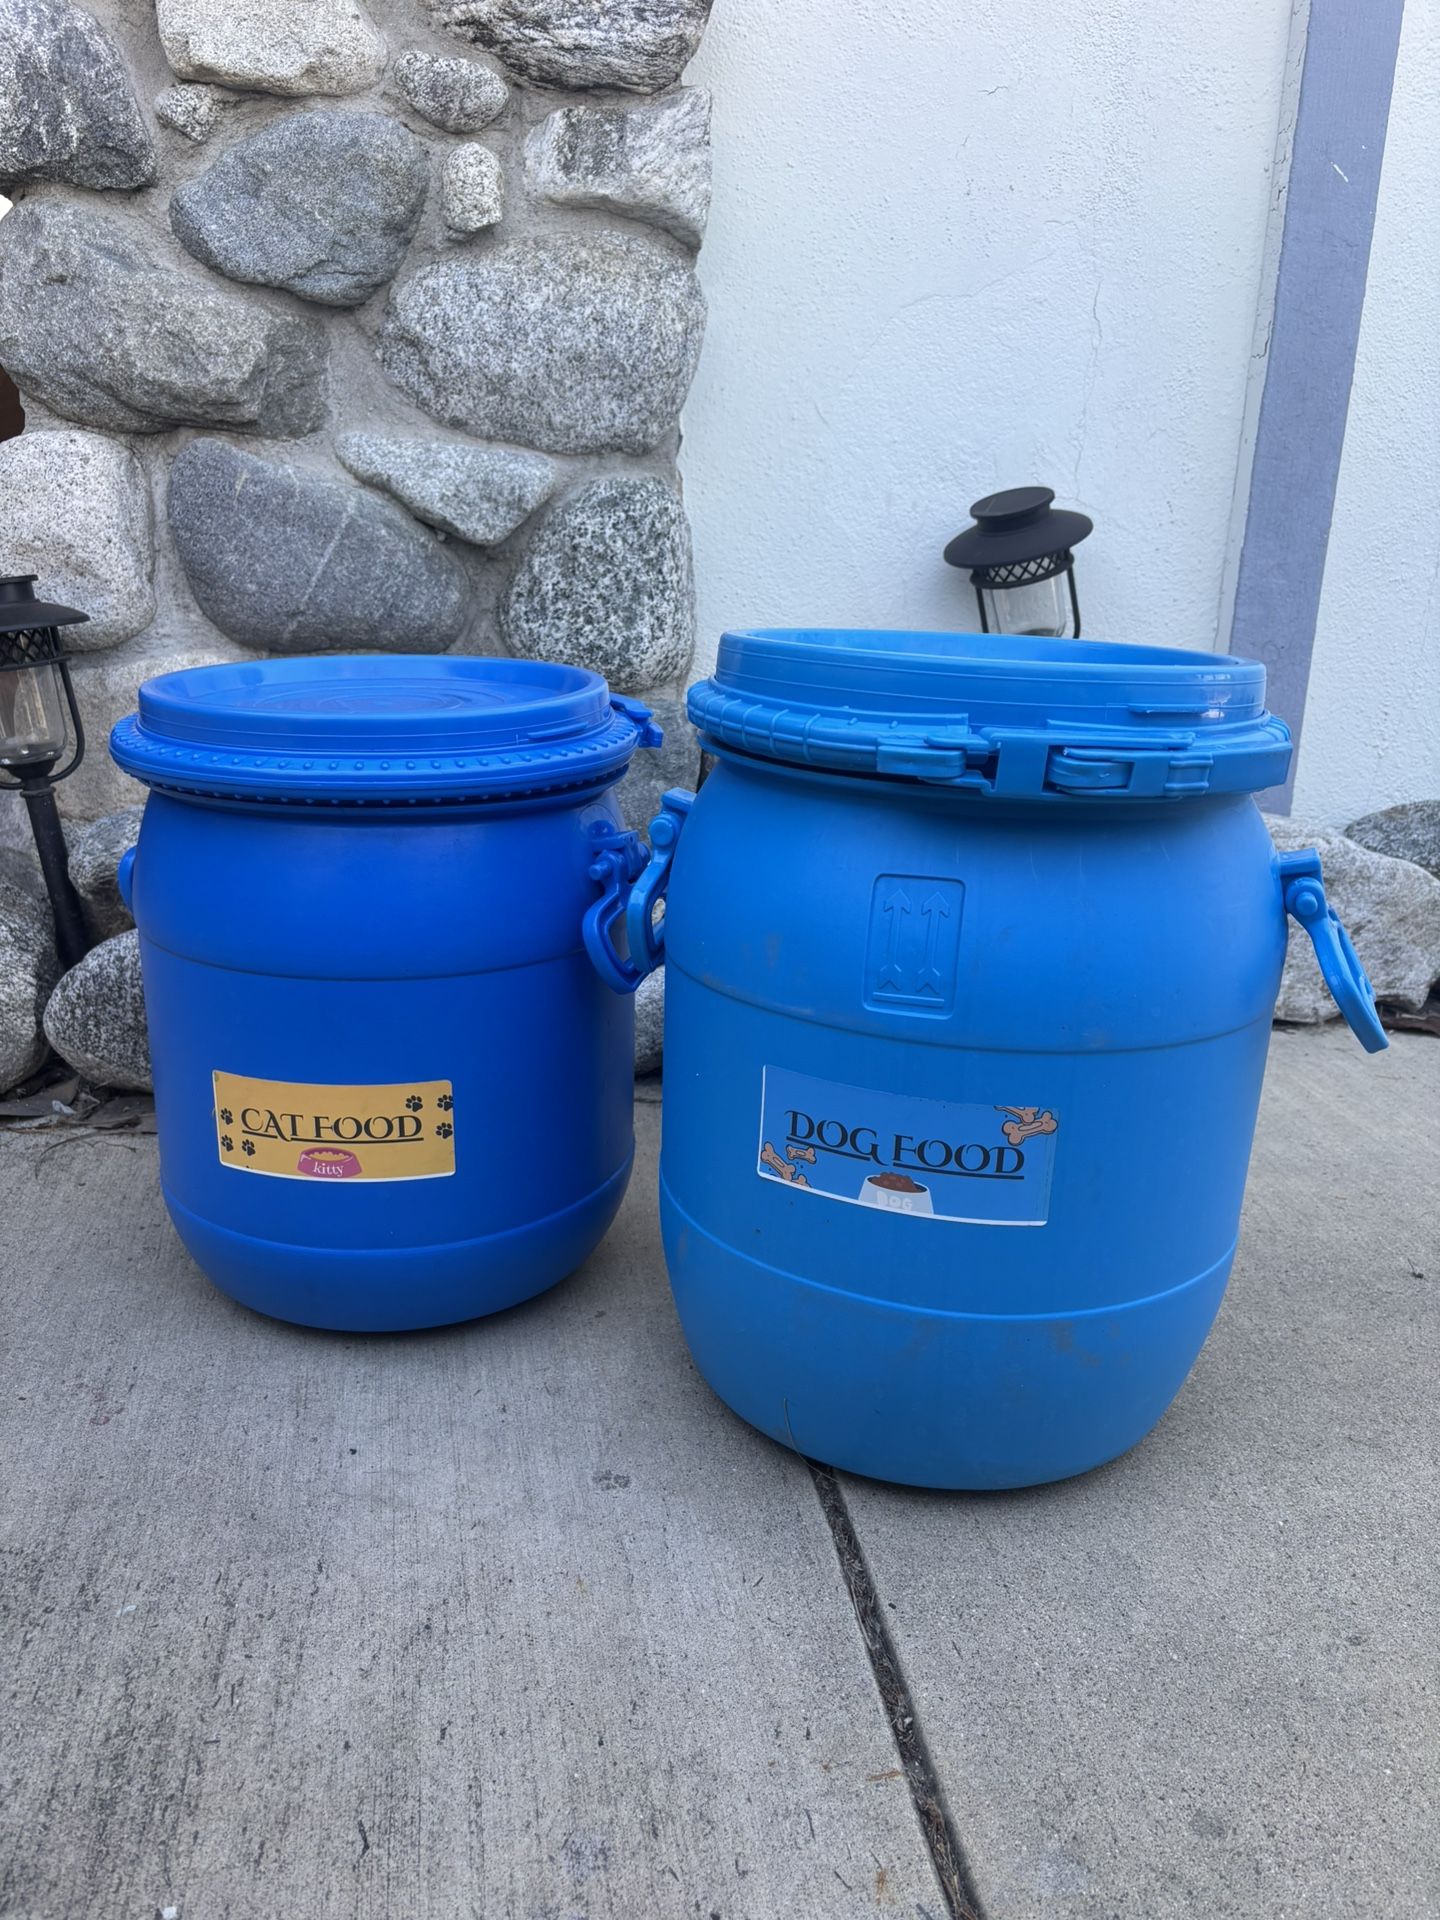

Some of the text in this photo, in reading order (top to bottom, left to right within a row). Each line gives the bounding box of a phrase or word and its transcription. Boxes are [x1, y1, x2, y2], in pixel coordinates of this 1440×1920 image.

[241, 1108, 422, 1141] CAT FOOD
[785, 1110, 1024, 1174] DOG FOOD
[313, 1161, 344, 1177] kitty
[877, 1191, 913, 1210] DOG
